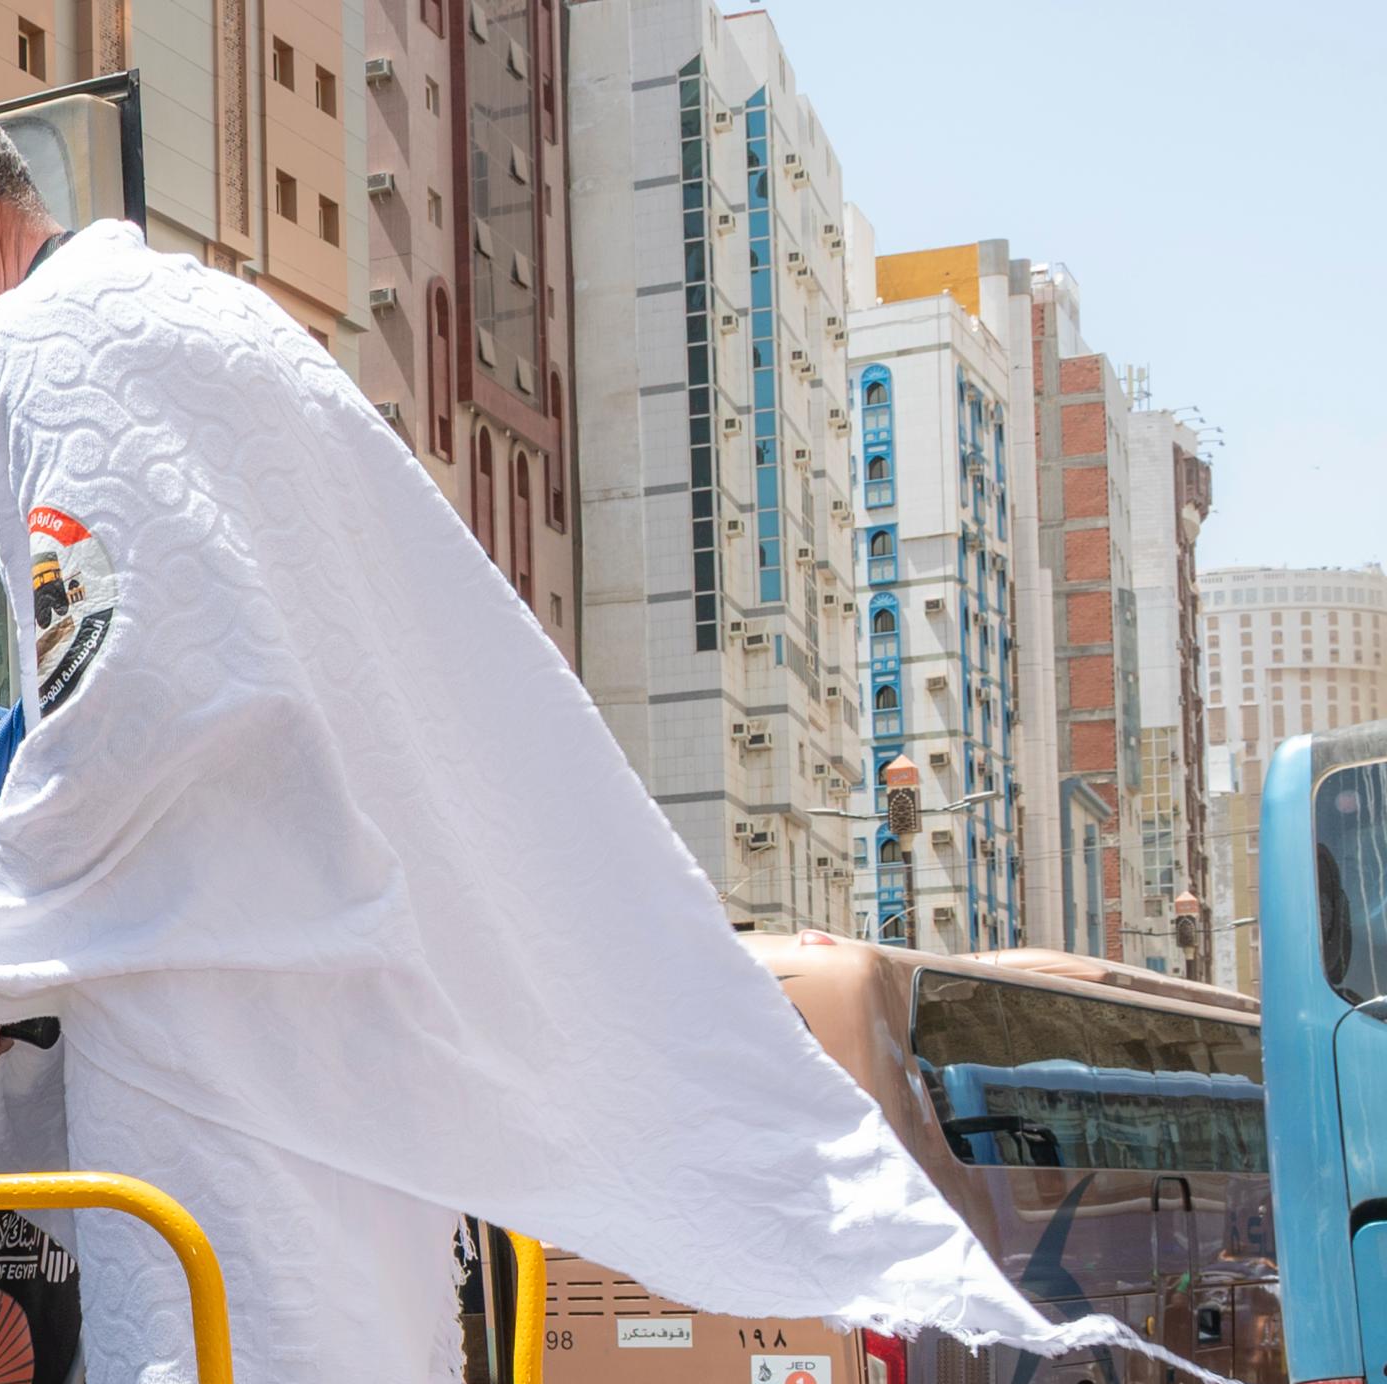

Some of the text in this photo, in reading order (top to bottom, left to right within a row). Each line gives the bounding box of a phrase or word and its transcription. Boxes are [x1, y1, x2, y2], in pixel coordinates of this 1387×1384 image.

[39, 619, 105, 709] المؤسسة القومي
[8, 1263, 38, 1280] EGYPT
[546, 1330, 574, 1350] 98
[621, 1328, 690, 1341] وقوف متكرر
[786, 1361, 816, 1370] JED
